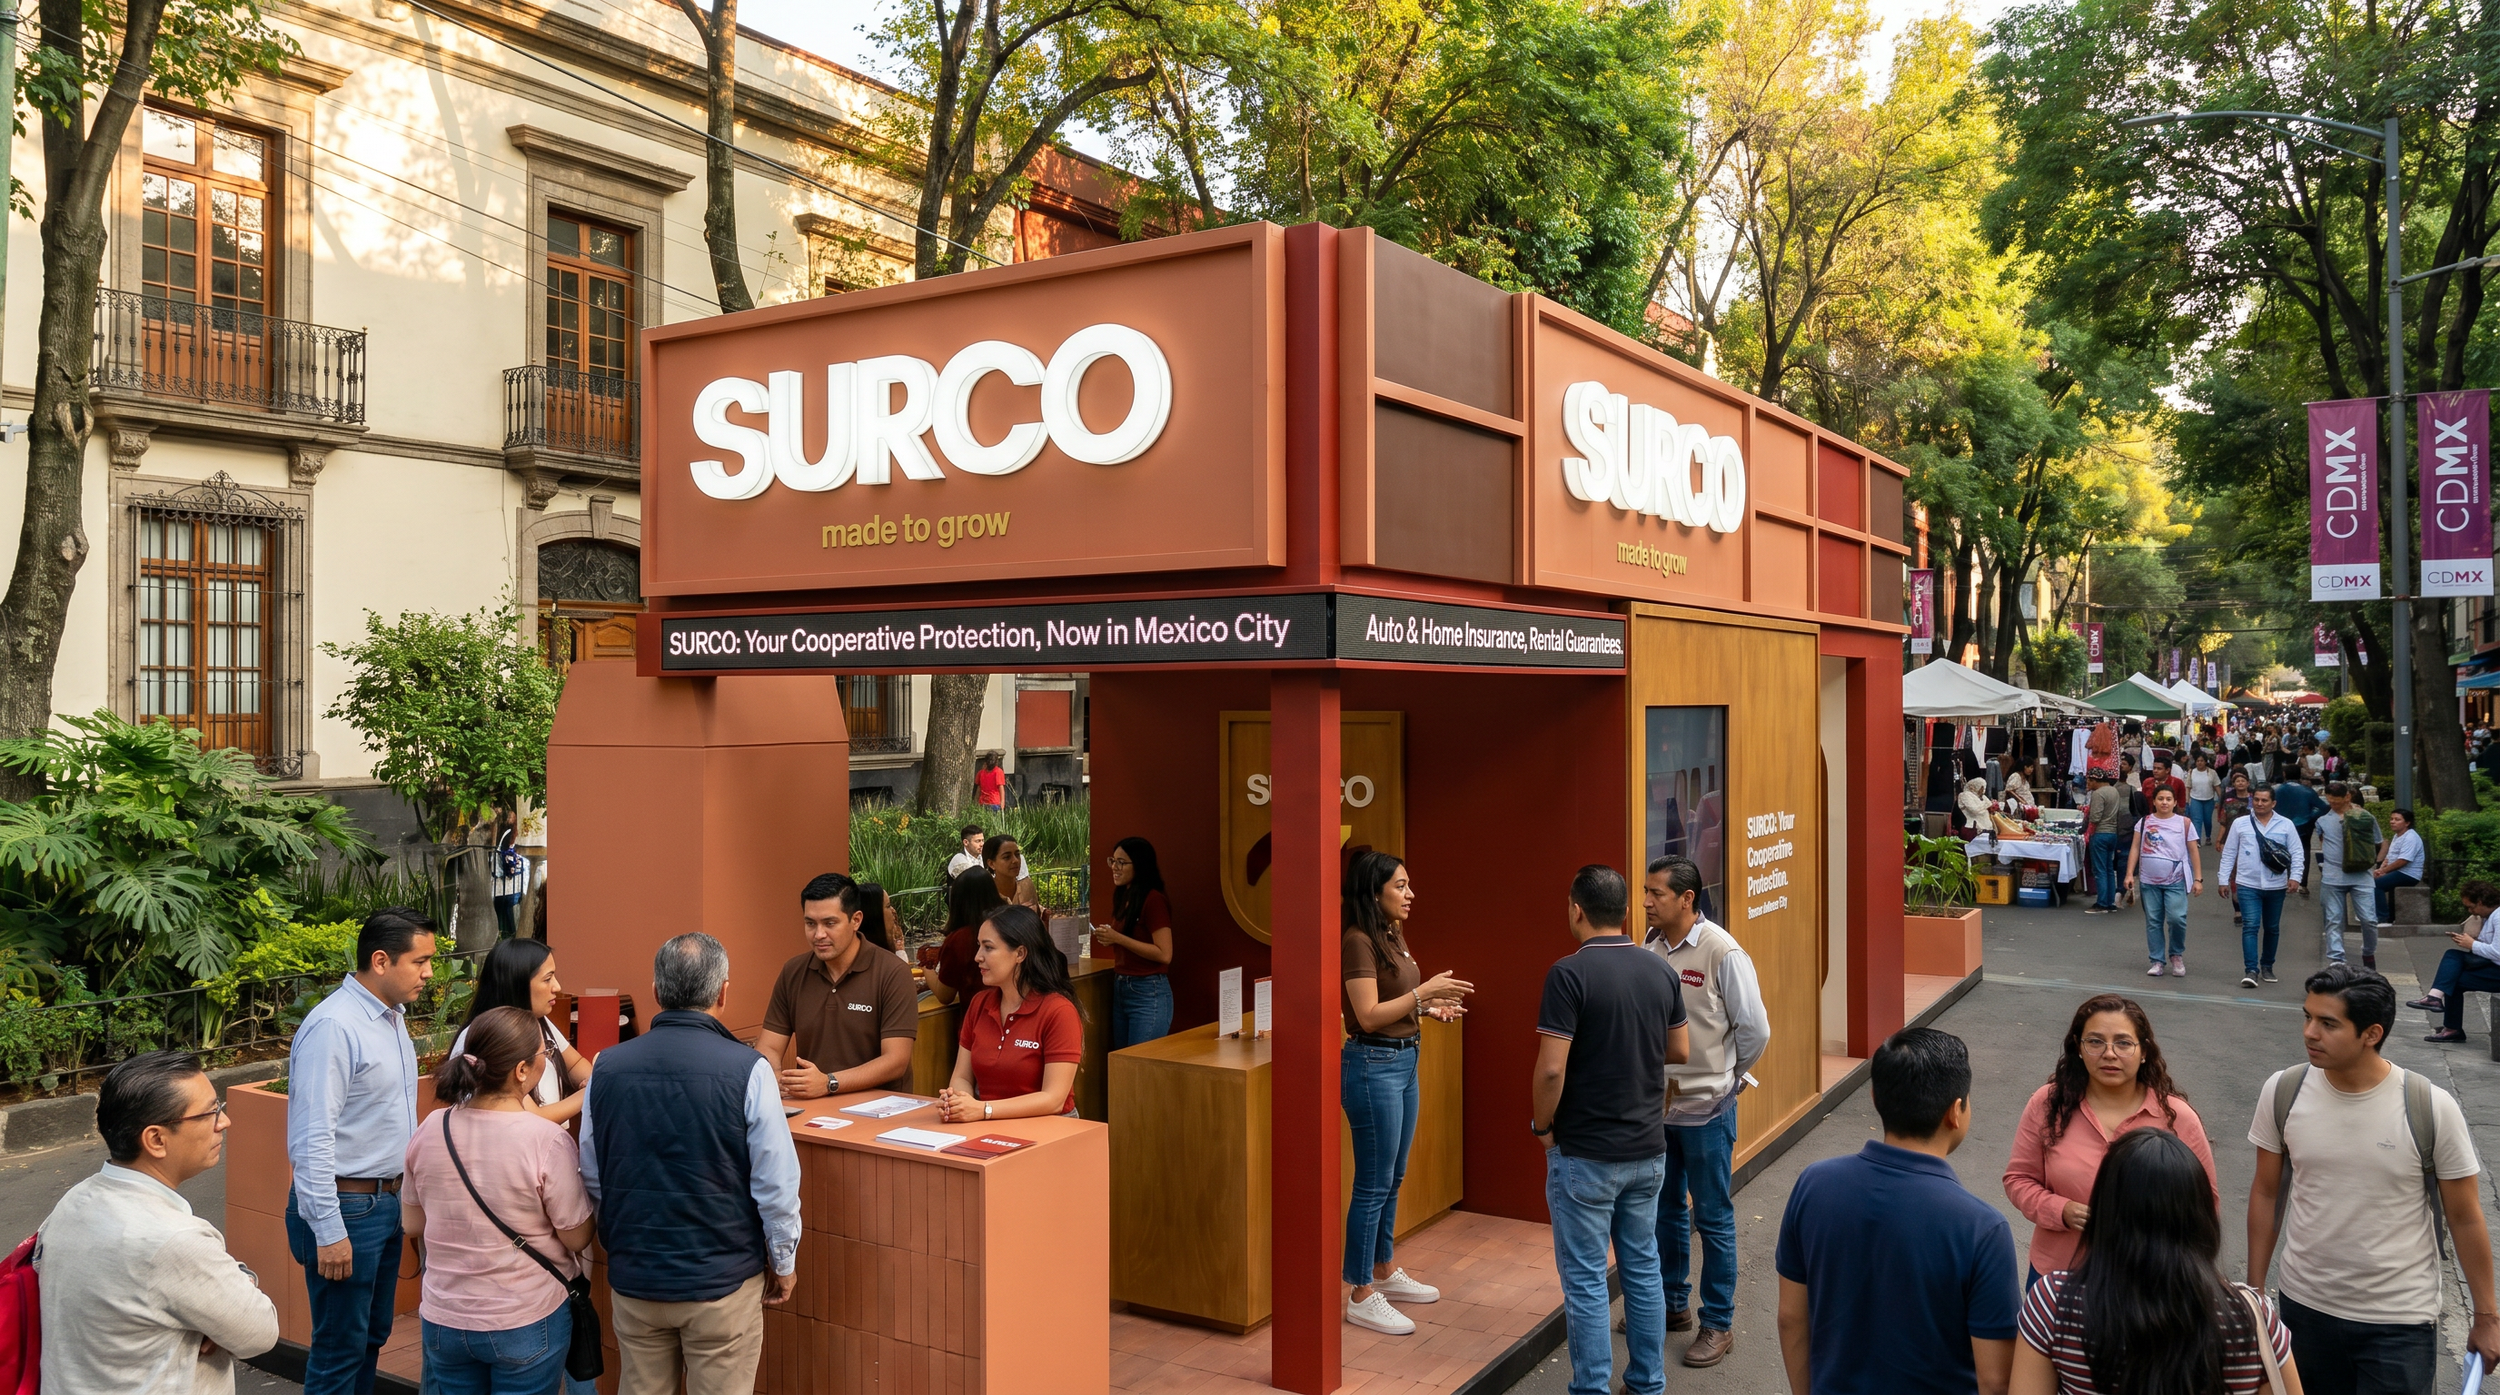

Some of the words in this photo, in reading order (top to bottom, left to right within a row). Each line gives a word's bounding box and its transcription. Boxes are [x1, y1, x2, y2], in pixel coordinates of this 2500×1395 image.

[689, 323, 1173, 500] SURCO
[1561, 380, 1746, 534] SURCO
[2435, 416, 2470, 533] CDMX
[2325, 426, 2358, 539] CDMX
[821, 514, 897, 548] made
[902, 514, 931, 542] to
[937, 511, 1011, 547] grow
[1617, 540, 1649, 566] made
[1650, 544, 1661, 570] to
[1662, 552, 1688, 578] grow
[2427, 570, 2484, 584] CDMX
[2317, 575, 2372, 589] CDMX
[669, 630, 741, 655] SURCO:
[744, 629, 788, 653] Your
[791, 625, 916, 658] Cooperative
[919, 621, 1041, 651] Protection,
[1047, 620, 1101, 646] Now
[1107, 617, 1128, 645] in
[1135, 615, 1229, 645] Mexico
[1234, 612, 1290, 648] City
[1365, 613, 1404, 643] Auto
[1406, 615, 1418, 644] &
[1421, 617, 1463, 647] Home
[1465, 621, 1528, 654] Insurance,
[1529, 626, 1564, 652] Rental
[1565, 629, 1624, 655] Guarantees.
[1747, 812, 1778, 839] SURCO:
[1777, 810, 1795, 832] Your
[847, 1002, 873, 1013] SURCO
